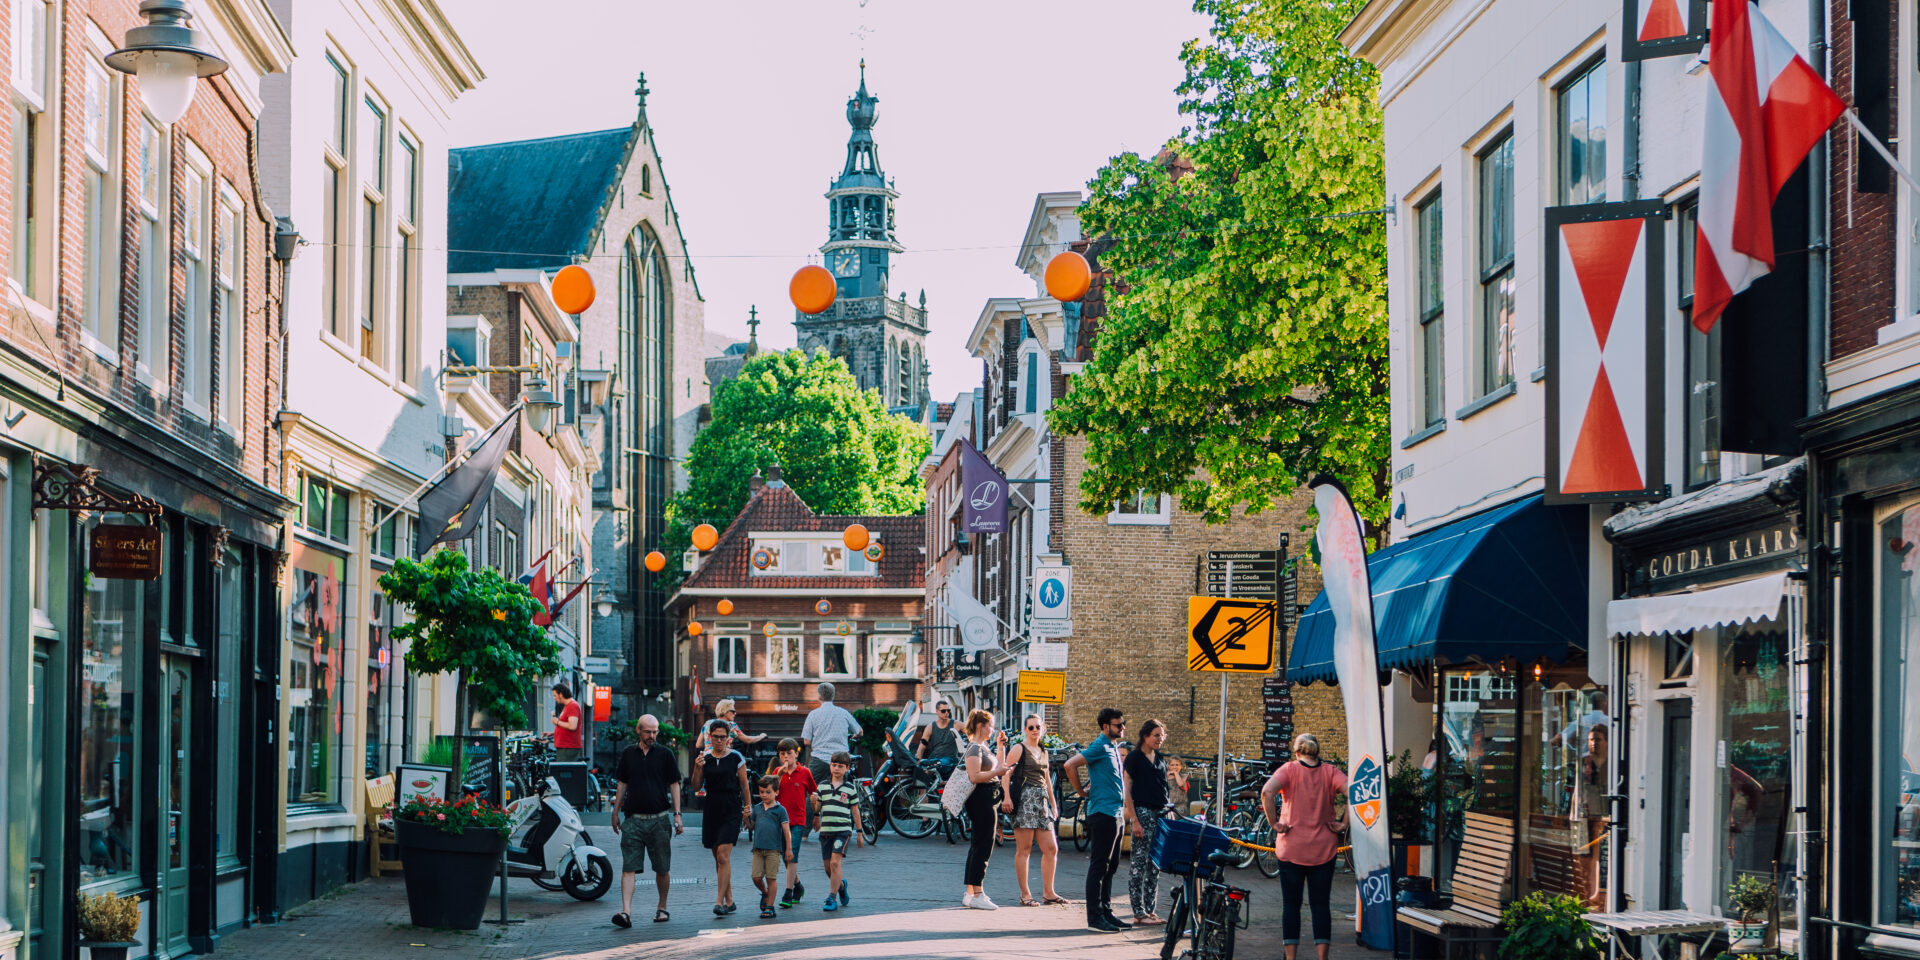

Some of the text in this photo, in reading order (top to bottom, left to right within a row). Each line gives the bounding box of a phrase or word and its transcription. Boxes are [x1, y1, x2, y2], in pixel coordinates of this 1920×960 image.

[137, 538, 156, 550] Act
[1650, 526, 1799, 579] GOUDA KAARS
[1219, 552, 1260, 560] Jeruzalemkapel
[1227, 617, 1246, 651] 2
